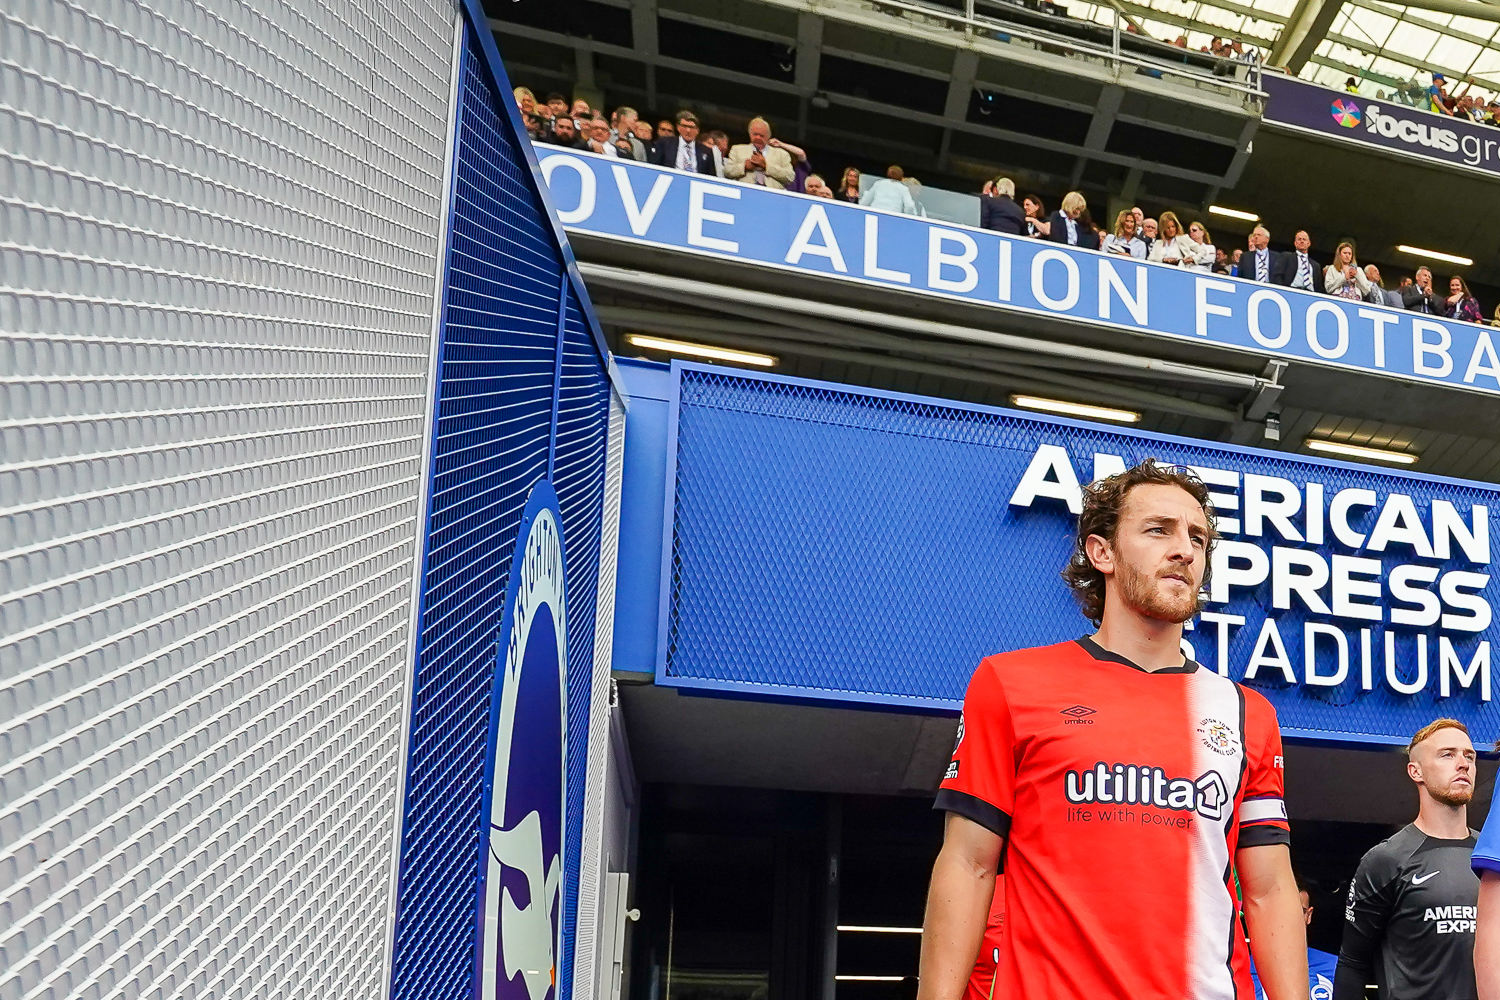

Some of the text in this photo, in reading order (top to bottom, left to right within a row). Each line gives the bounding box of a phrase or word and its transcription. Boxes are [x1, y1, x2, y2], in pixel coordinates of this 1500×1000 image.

[784, 204, 1149, 327] ALBION
[1199, 540, 1492, 633] PRESS
[1066, 761, 1196, 812] utilita
[1067, 807, 1194, 829] life with power
